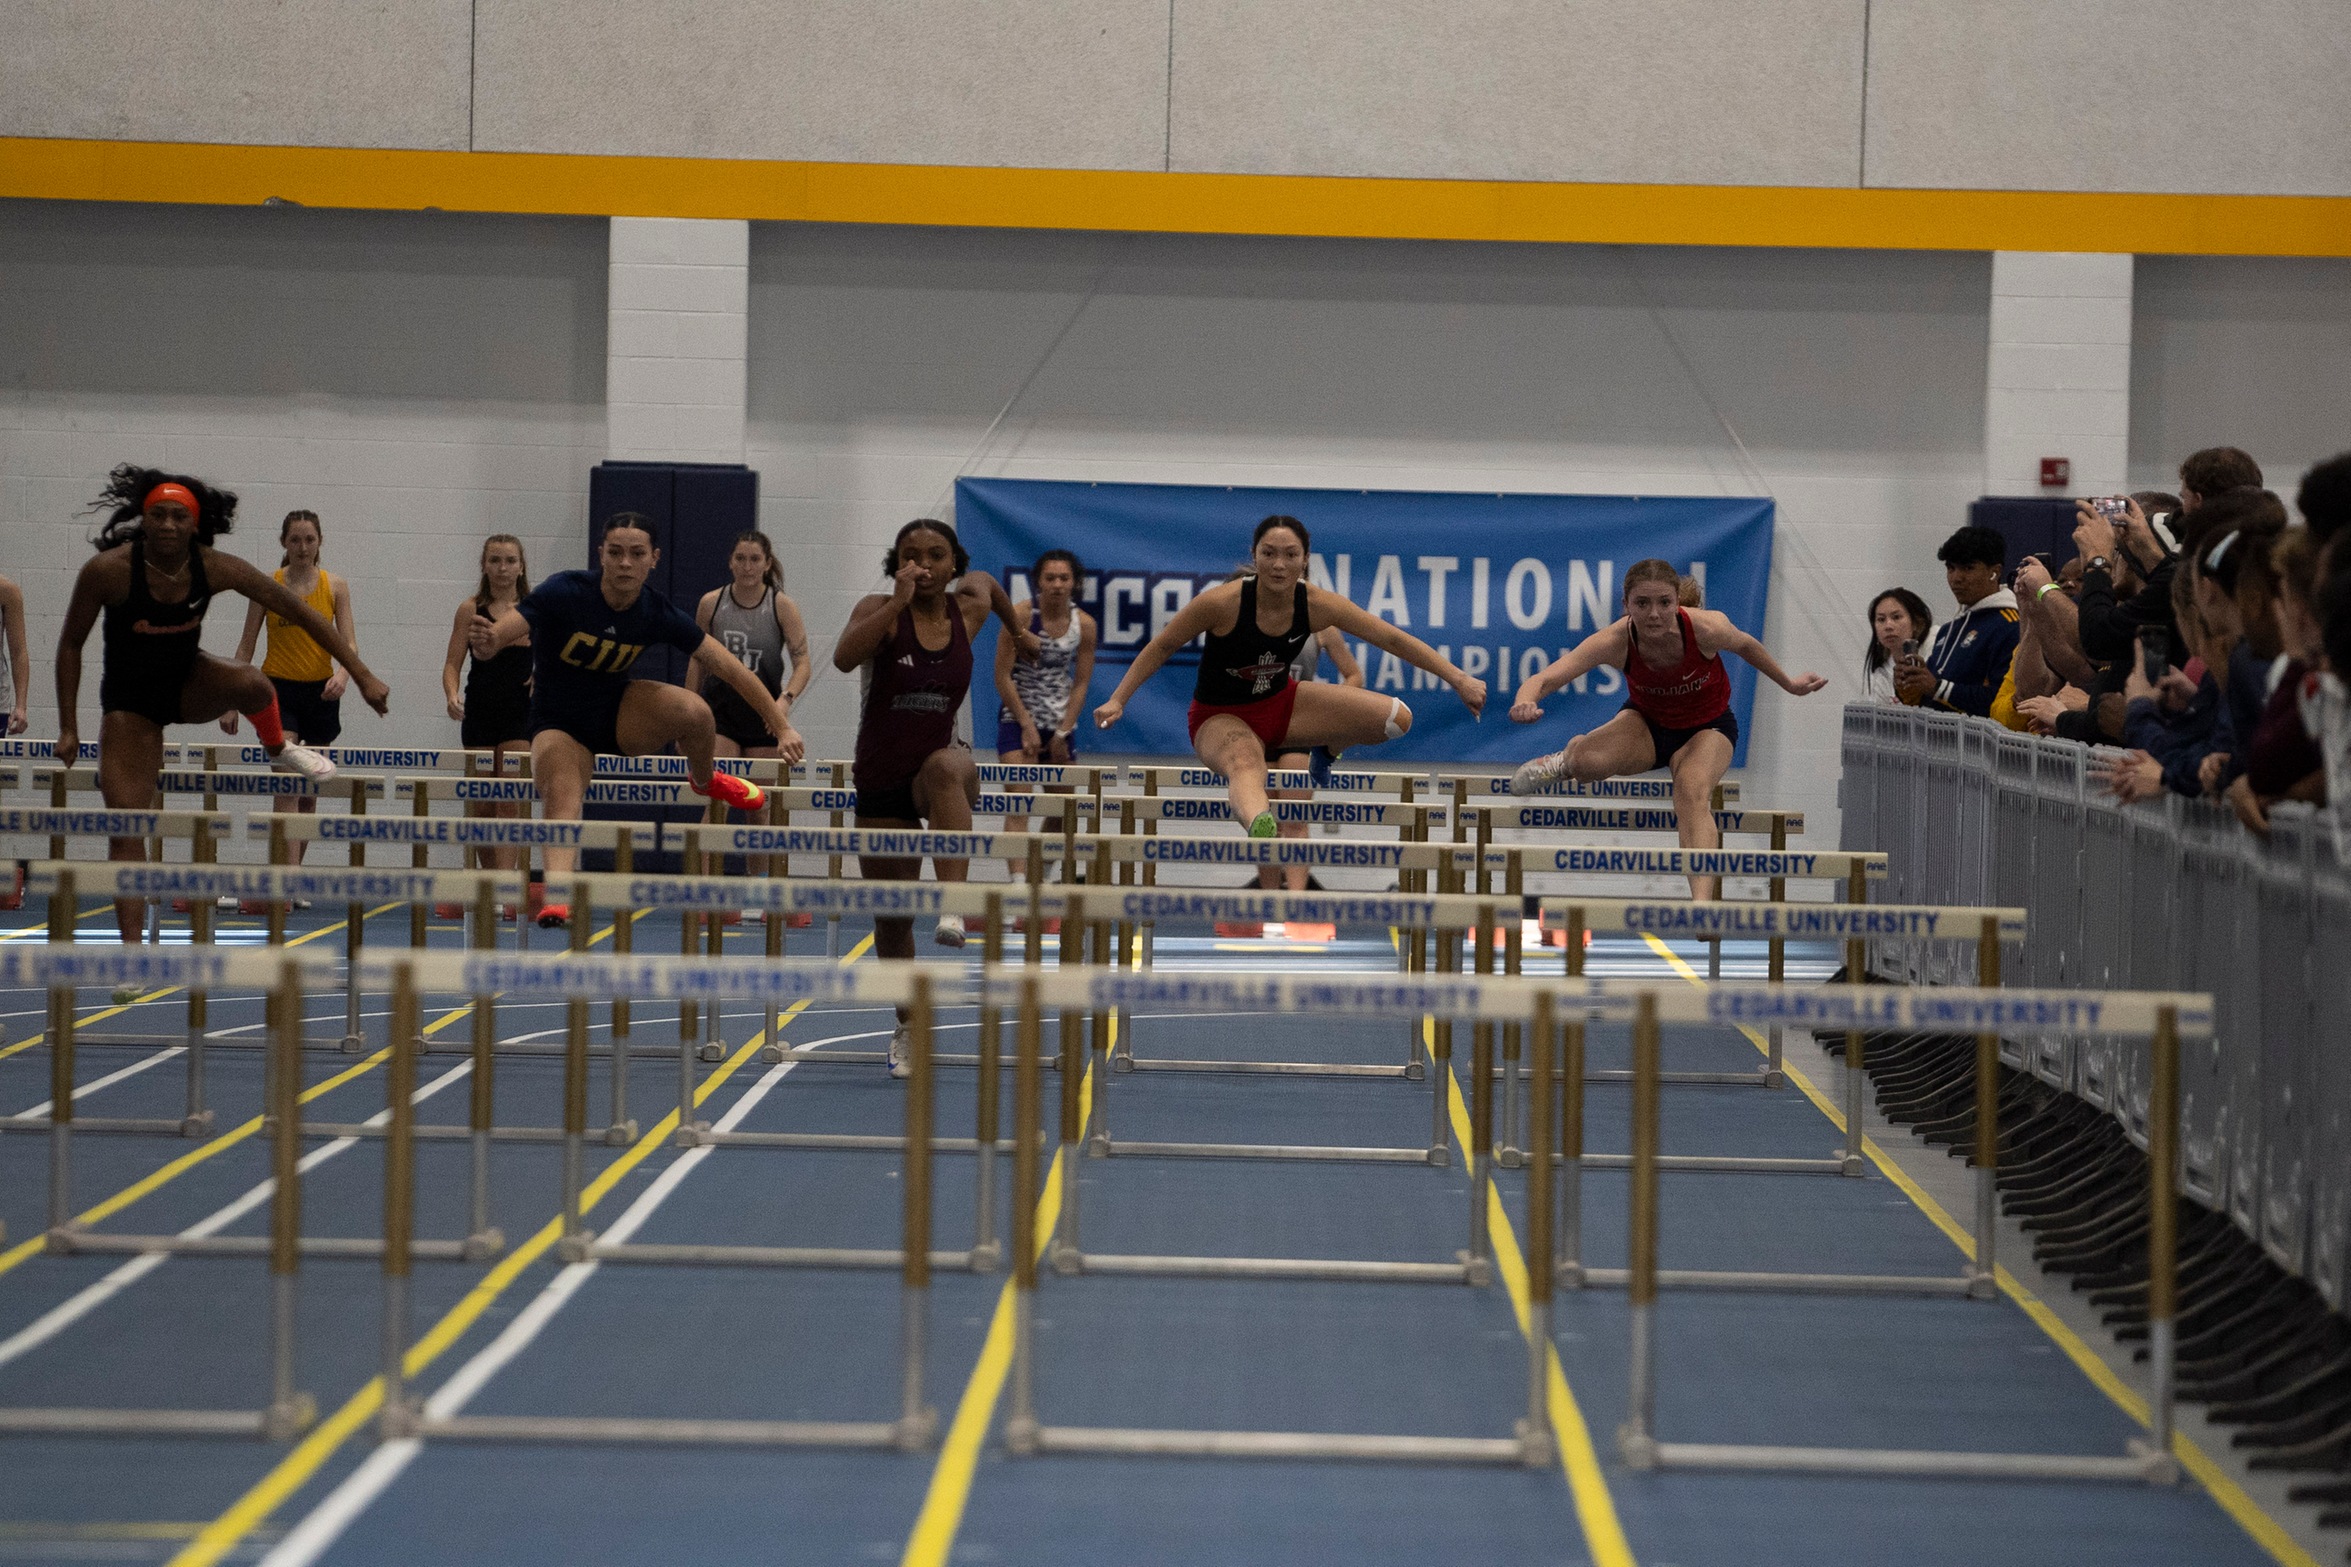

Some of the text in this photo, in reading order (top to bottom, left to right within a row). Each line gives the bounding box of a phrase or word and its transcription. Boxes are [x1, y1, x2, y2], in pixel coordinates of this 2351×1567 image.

[1308, 553, 1706, 632] NATION
[559, 631, 646, 673] CIU
[1313, 643, 1622, 695] HAMPIONS
[343, 750, 440, 766] UNIVERSITY
[593, 756, 753, 775] RVILLE UNISITY
[455, 781, 682, 802] CEDARVI NIVERSITY
[1181, 770, 1377, 789] CEDAE UNIVRSITY
[1490, 778, 1674, 797] CEVILLE UNIVERSIT
[971, 795, 1036, 813] ERSITY
[1162, 800, 1386, 822] CEDARV UNIVERSITY
[29, 812, 159, 833] UNIVERSITY
[319, 818, 582, 843] CEDARVILLE UNIVERSITY
[1519, 808, 1744, 830] CEDARVILLE UNIVITY
[733, 829, 994, 854] CEDARVILLE UNIVERSITY
[1143, 840, 1404, 865] CEDARVILLE UNIVERSITY
[1554, 850, 1817, 874] CEDARVILLE UNIVERSITY
[116, 869, 435, 897] CEDARVILLE UNIVERSITY
[629, 881, 942, 908] CEDARVILLE UNIVERSITY
[1122, 893, 1434, 922] CEDARVILLE UNIVERSITY
[1624, 905, 1939, 933] CEDARVILLE UNIVERSITY
